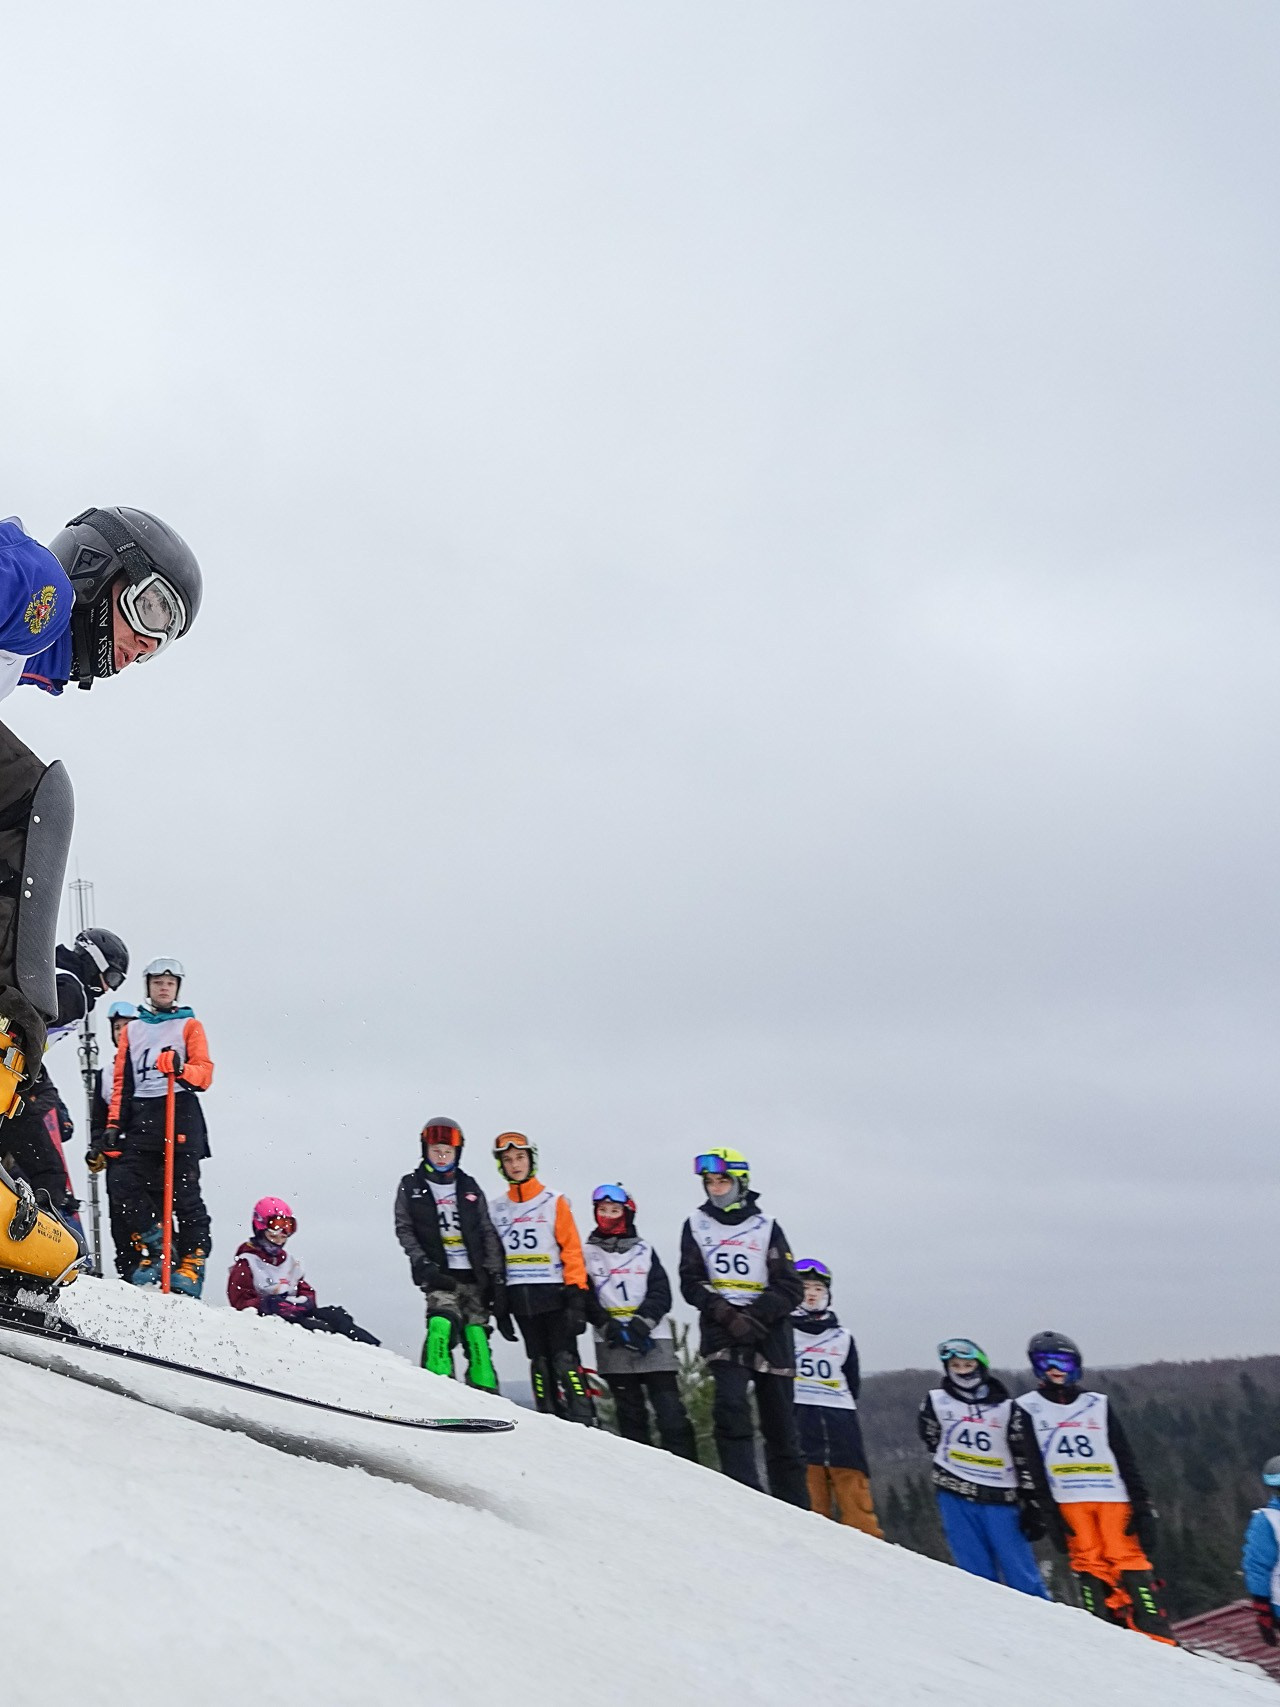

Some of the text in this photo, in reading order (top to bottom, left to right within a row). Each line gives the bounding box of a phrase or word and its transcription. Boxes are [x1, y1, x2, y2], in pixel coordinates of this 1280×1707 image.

[116, 541, 136, 553] uvex
[98, 634, 109, 678] LLFLEX
[508, 1228, 538, 1250] 35
[714, 1252, 750, 1275] 56
[615, 1280, 630, 1302] 1
[800, 1358, 832, 1379] 50
[957, 1428, 992, 1452] 46
[1057, 1434, 1094, 1458] 48
